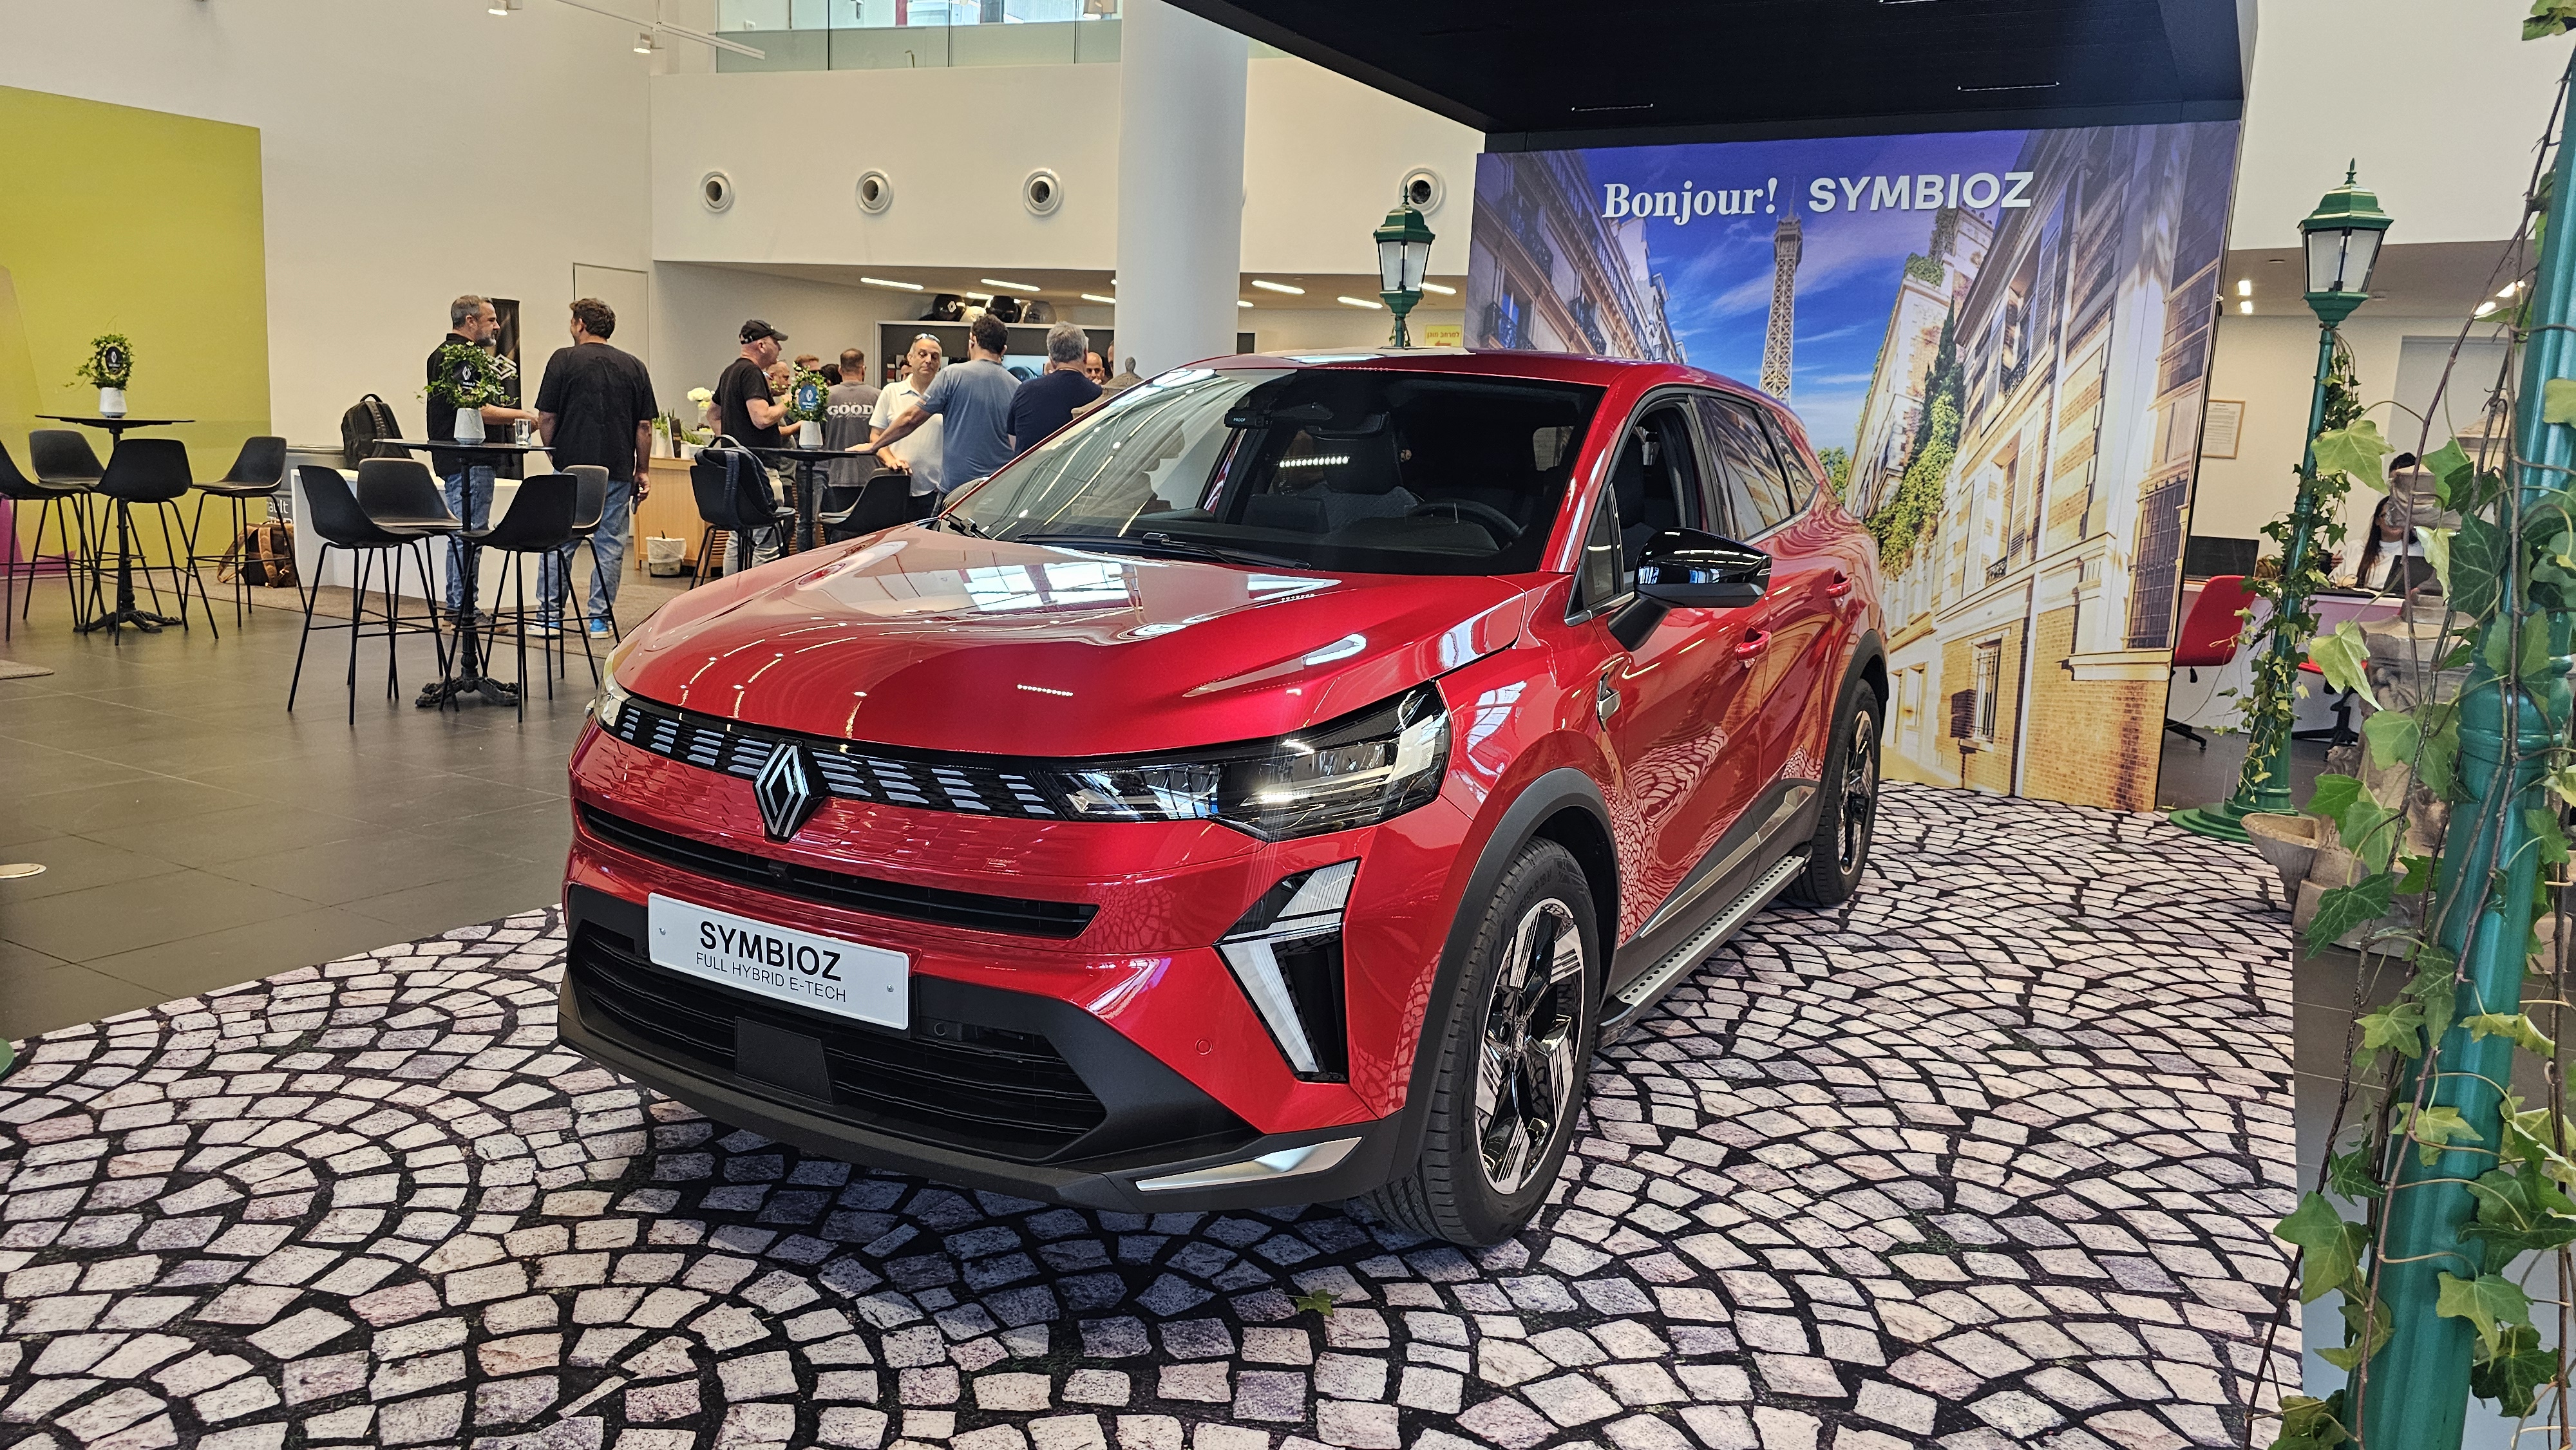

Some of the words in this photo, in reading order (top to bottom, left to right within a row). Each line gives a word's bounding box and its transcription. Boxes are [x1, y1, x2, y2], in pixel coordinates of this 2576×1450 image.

[1603, 177, 1778, 225] Bonjour!
[1808, 171, 2035, 212] SYMBIOZ
[826, 404, 874, 415] GOOD
[696, 952, 728, 974] FULL
[732, 961, 784, 987] HYBRID
[790, 977, 846, 1003] E-TECH
[699, 921, 842, 982] SYMBIOZ
